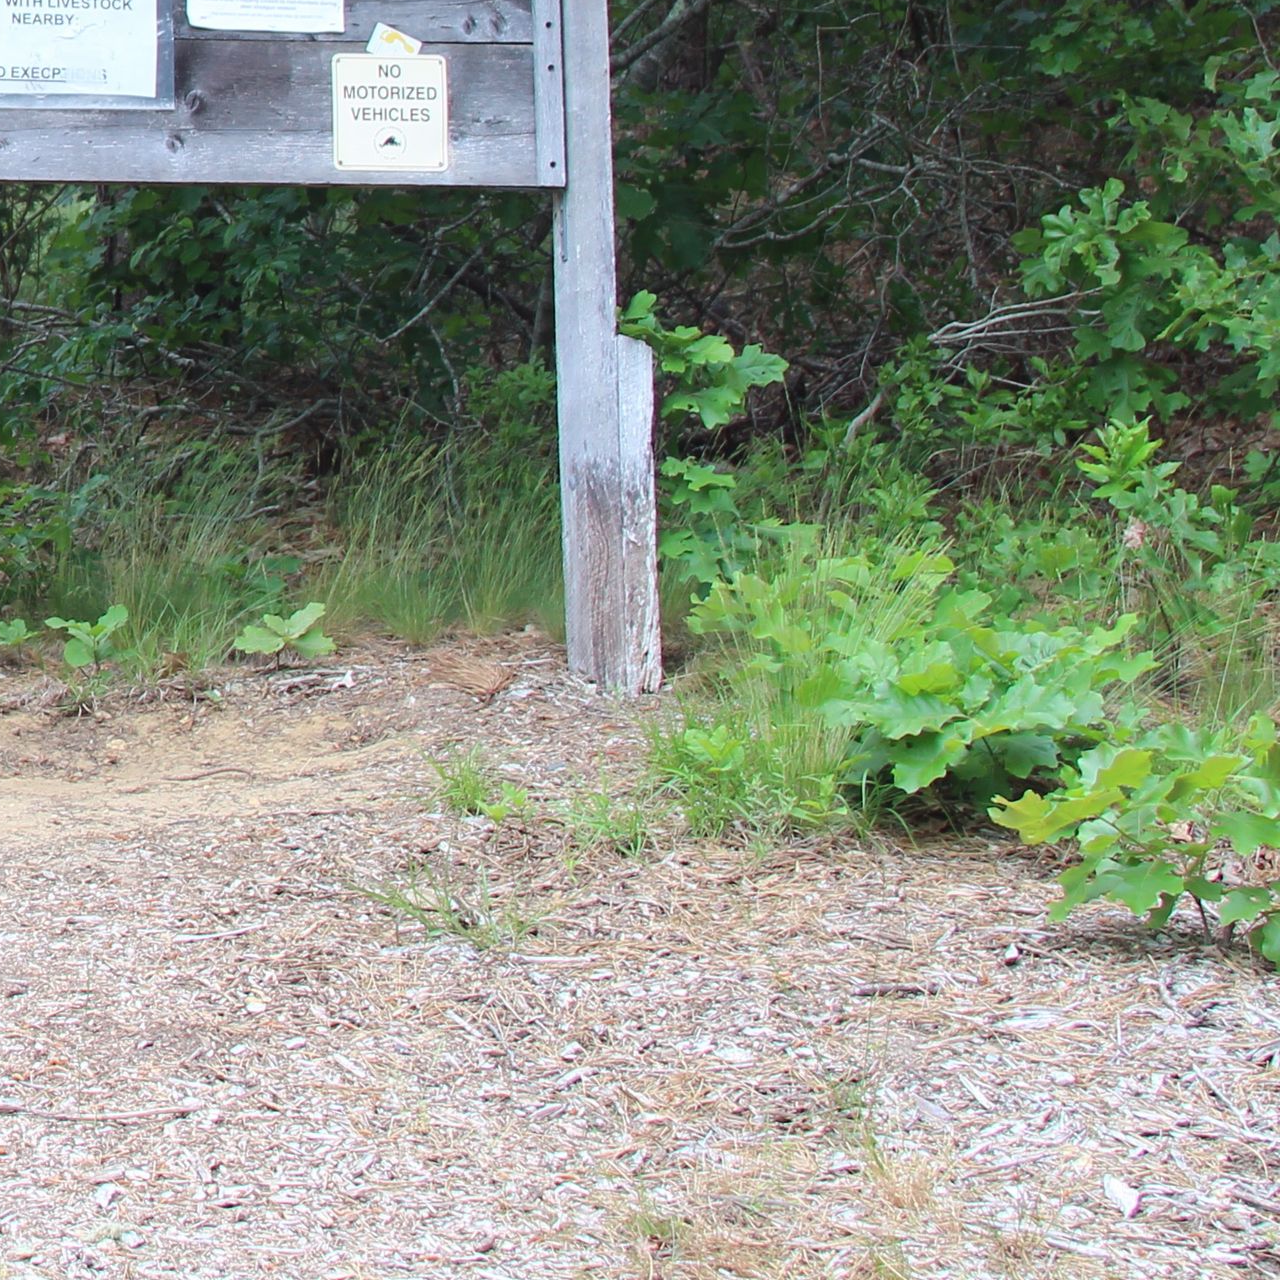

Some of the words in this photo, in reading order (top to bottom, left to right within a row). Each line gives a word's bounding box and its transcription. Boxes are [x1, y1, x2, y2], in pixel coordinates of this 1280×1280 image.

[378, 65, 401, 78] NO
[343, 86, 437, 100] MOTORIZED
[352, 108, 430, 121] VEHICLES
